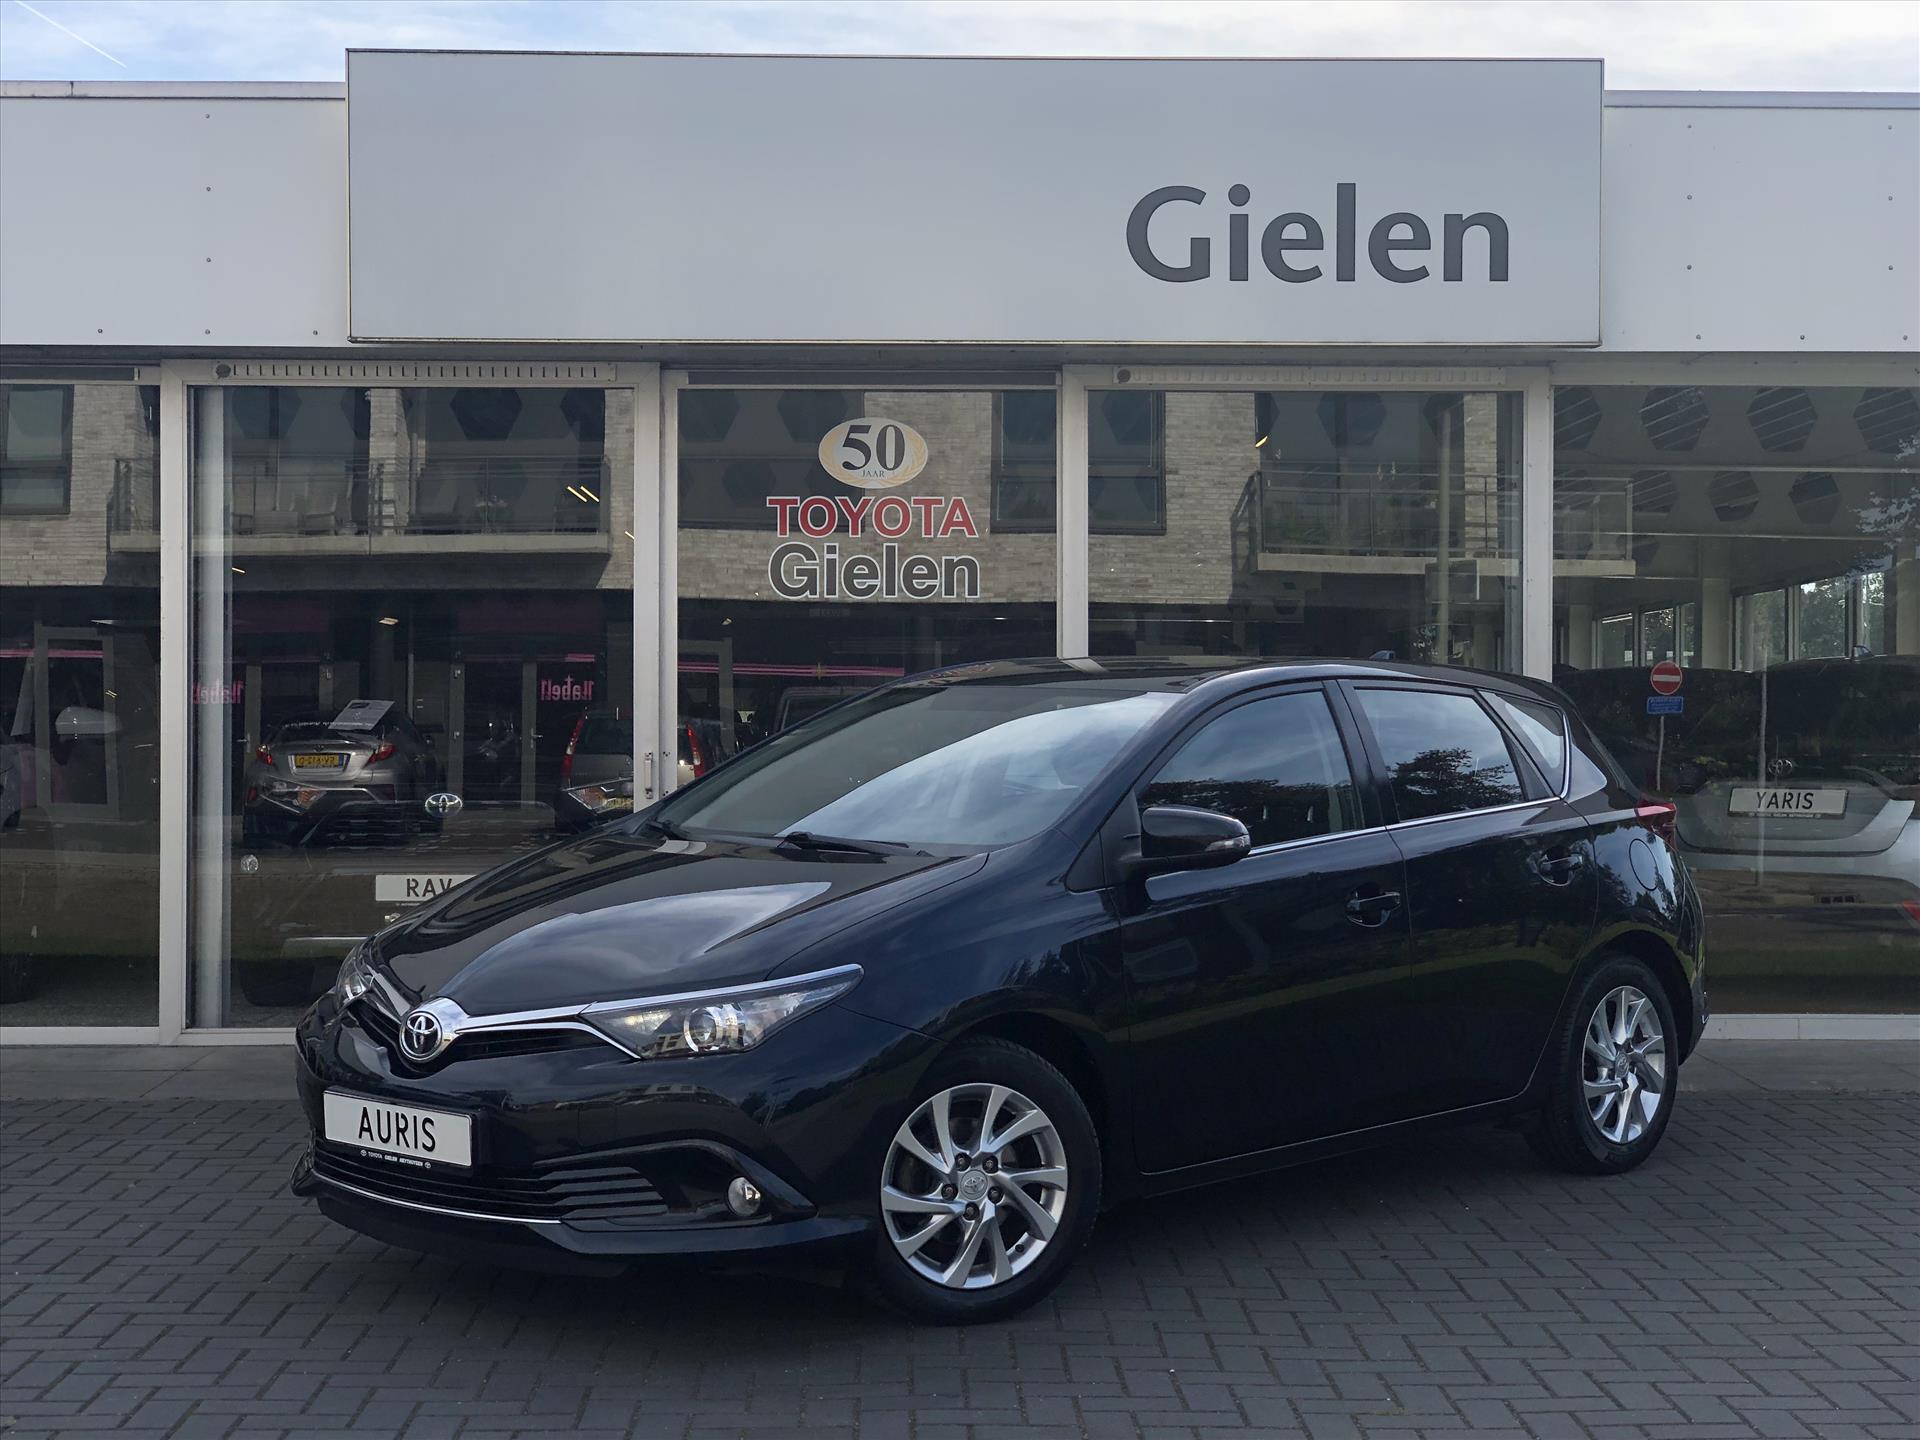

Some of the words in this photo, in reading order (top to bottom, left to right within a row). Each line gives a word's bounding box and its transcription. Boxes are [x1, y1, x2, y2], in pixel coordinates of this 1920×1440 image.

[1126, 183, 1509, 283] Gielen
[842, 424, 906, 471] 50
[766, 495, 979, 539] TOYOTA
[768, 541, 980, 599] Gielen
[1756, 791, 1814, 810] YARIS
[358, 1106, 436, 1152] AURIS
